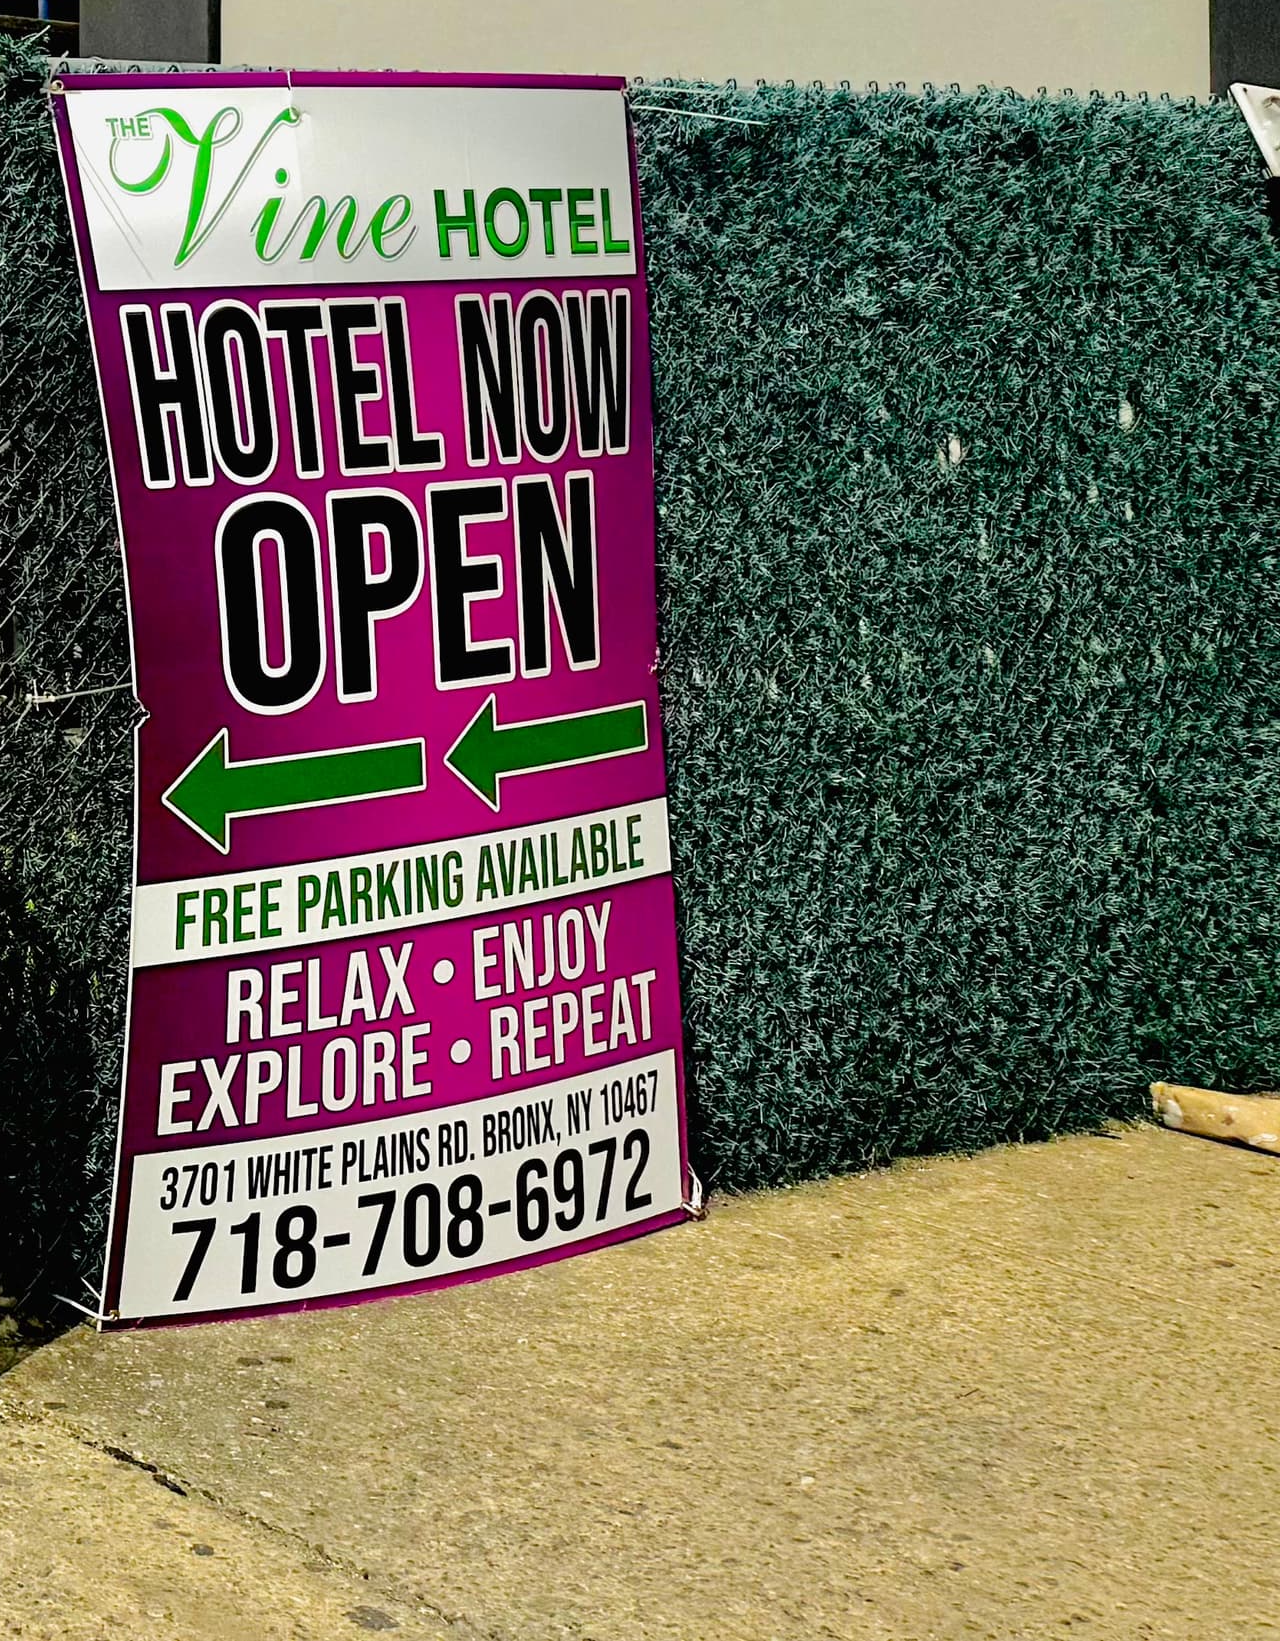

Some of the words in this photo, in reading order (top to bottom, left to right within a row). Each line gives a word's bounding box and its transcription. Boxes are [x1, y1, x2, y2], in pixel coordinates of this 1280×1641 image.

[105, 116, 152, 139] THE
[109, 105, 418, 268] Vine
[434, 187, 631, 259] HOTEL
[119, 296, 445, 489] HOTEL
[454, 288, 631, 467] NOW
[214, 469, 601, 716] OPEN
[175, 879, 283, 951] FREE
[297, 850, 464, 933] PARKING
[476, 814, 645, 903] AVAILABLE
[226, 941, 416, 1044] RELAX
[472, 900, 612, 1002] ENJOY
[156, 1023, 433, 1137] EXPLORE
[489, 970, 657, 1081] REPEAT
[160, 1165, 235, 1211] 3701
[246, 1145, 334, 1200] WHITE
[341, 1134, 431, 1186] PLAINS
[437, 1123, 476, 1169] RD.
[482, 1104, 562, 1159] BRONX,
[566, 1096, 593, 1138] NY
[598, 1069, 659, 1124] 10467
[172, 1128, 653, 1303] 718-708-6972
